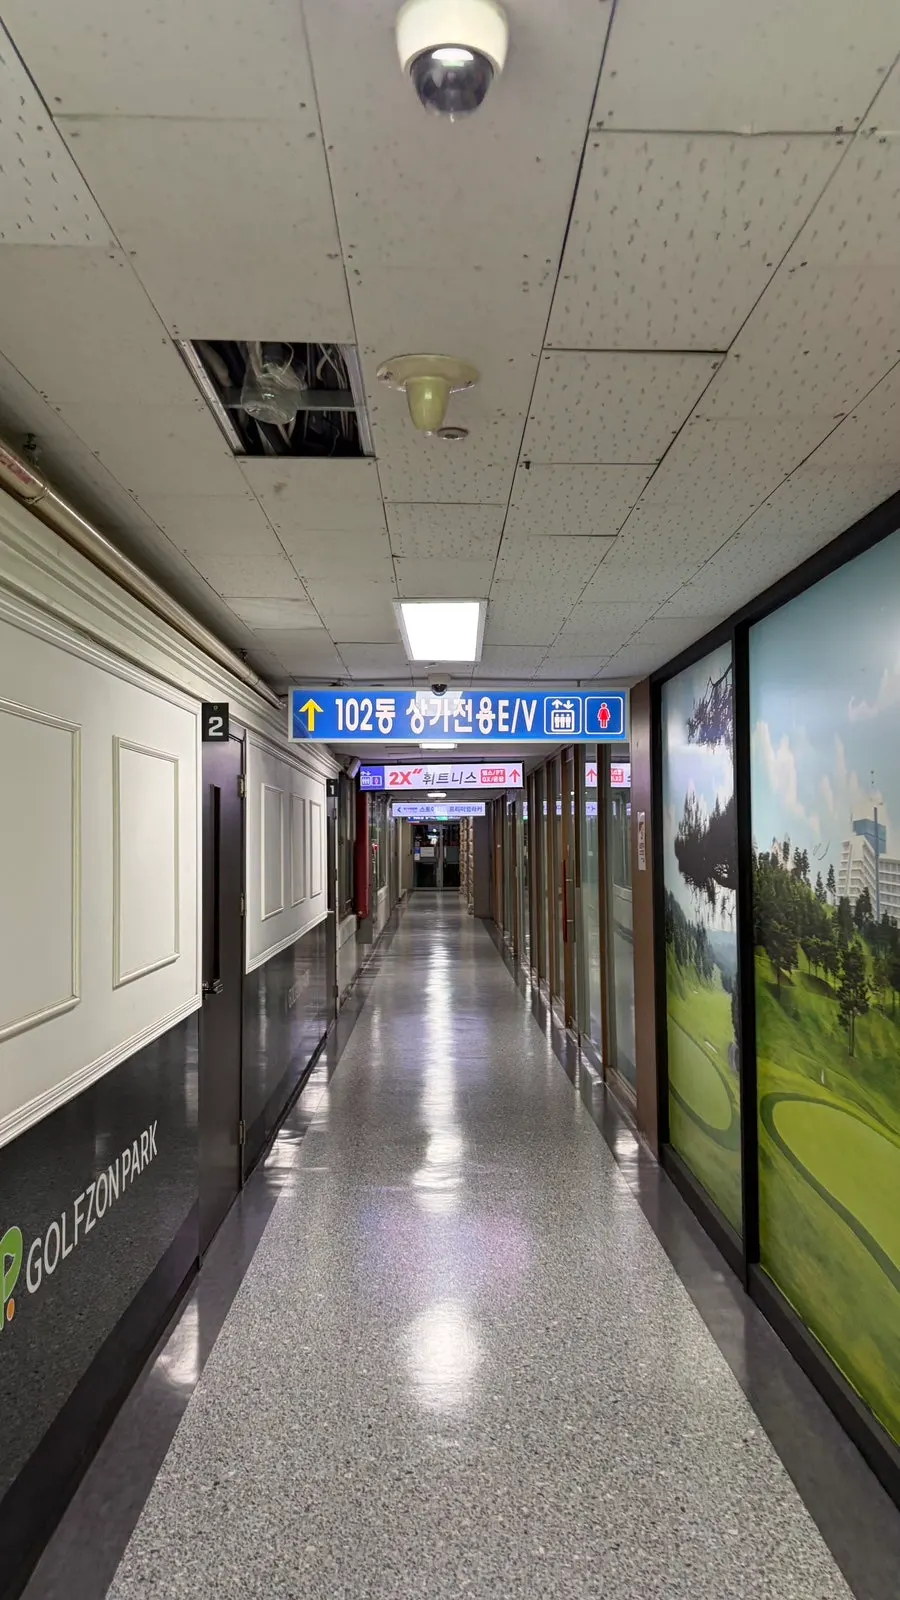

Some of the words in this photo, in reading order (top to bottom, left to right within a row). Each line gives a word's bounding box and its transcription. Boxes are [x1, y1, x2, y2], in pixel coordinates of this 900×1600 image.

[208, 716, 224, 737] 2
[335, 698, 396, 734] 102동
[422, 771, 477, 785] 휘트니스
